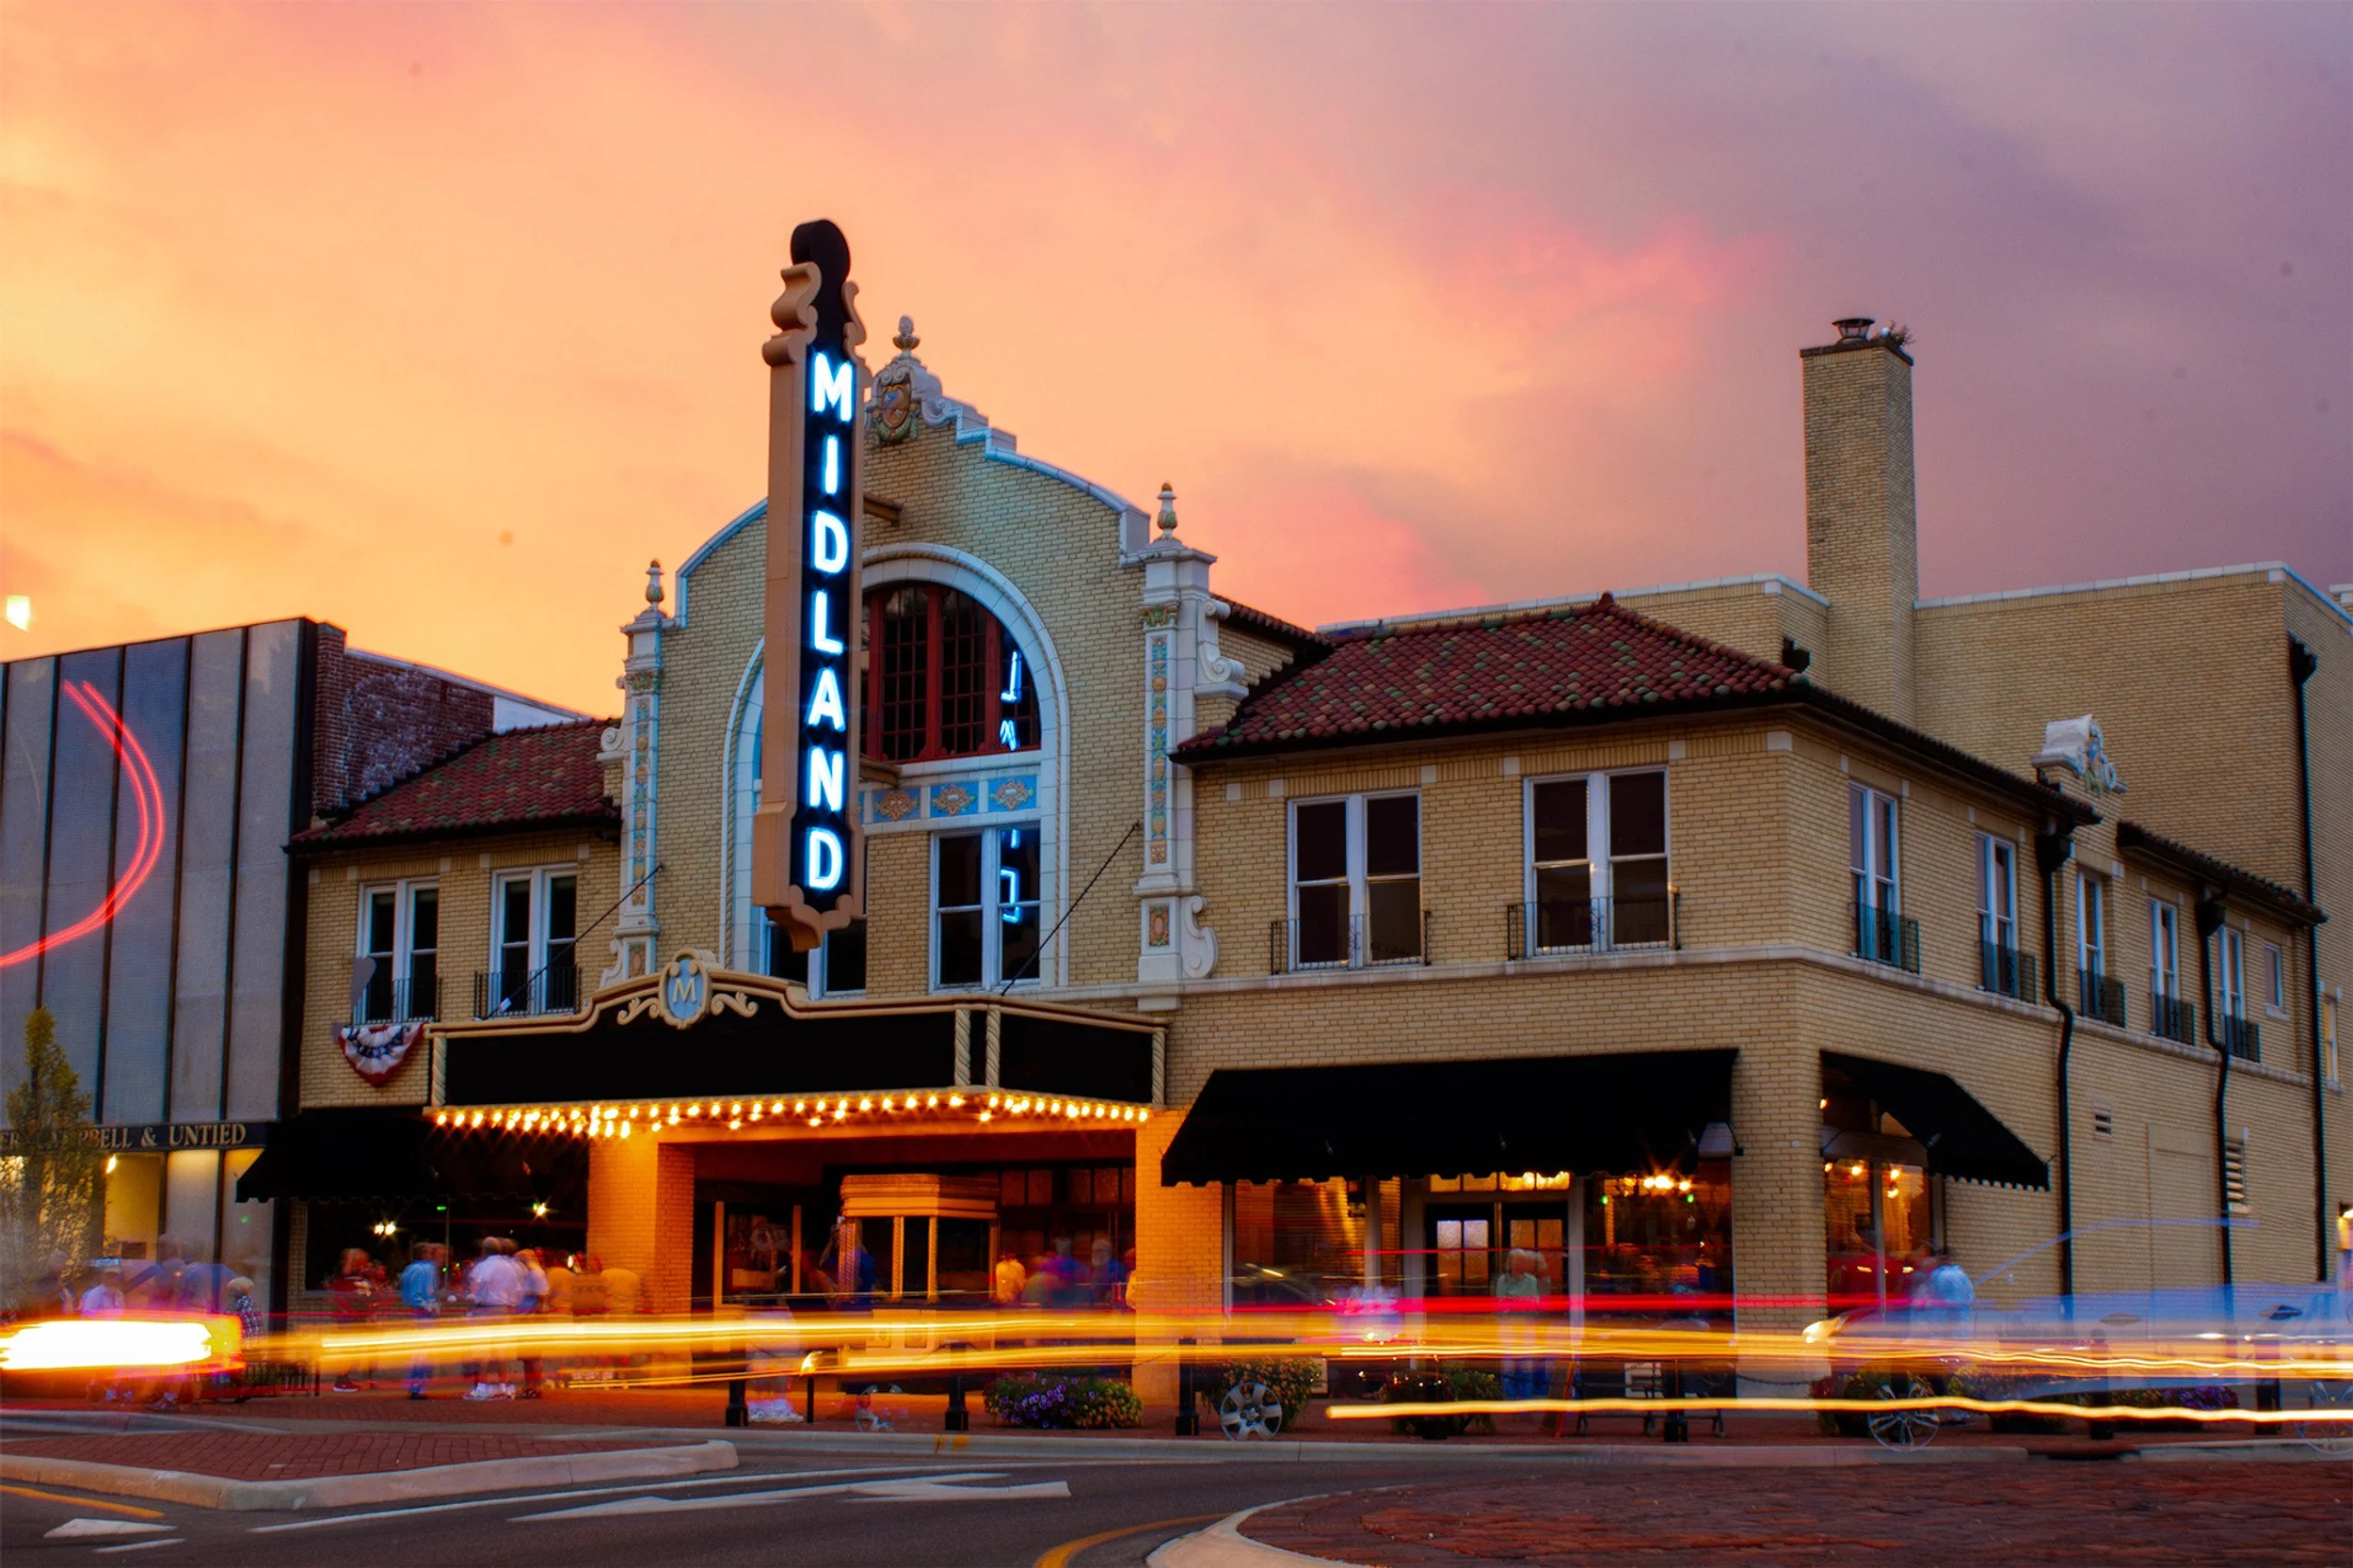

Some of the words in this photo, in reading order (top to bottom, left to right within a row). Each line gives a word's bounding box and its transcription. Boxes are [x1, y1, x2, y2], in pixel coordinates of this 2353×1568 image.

[808, 351, 853, 889] MIDLAND
[673, 977, 697, 1003] M
[37, 1128, 132, 1149] APBELL
[140, 1127, 157, 1147] &
[169, 1123, 246, 1147] UNTIED
